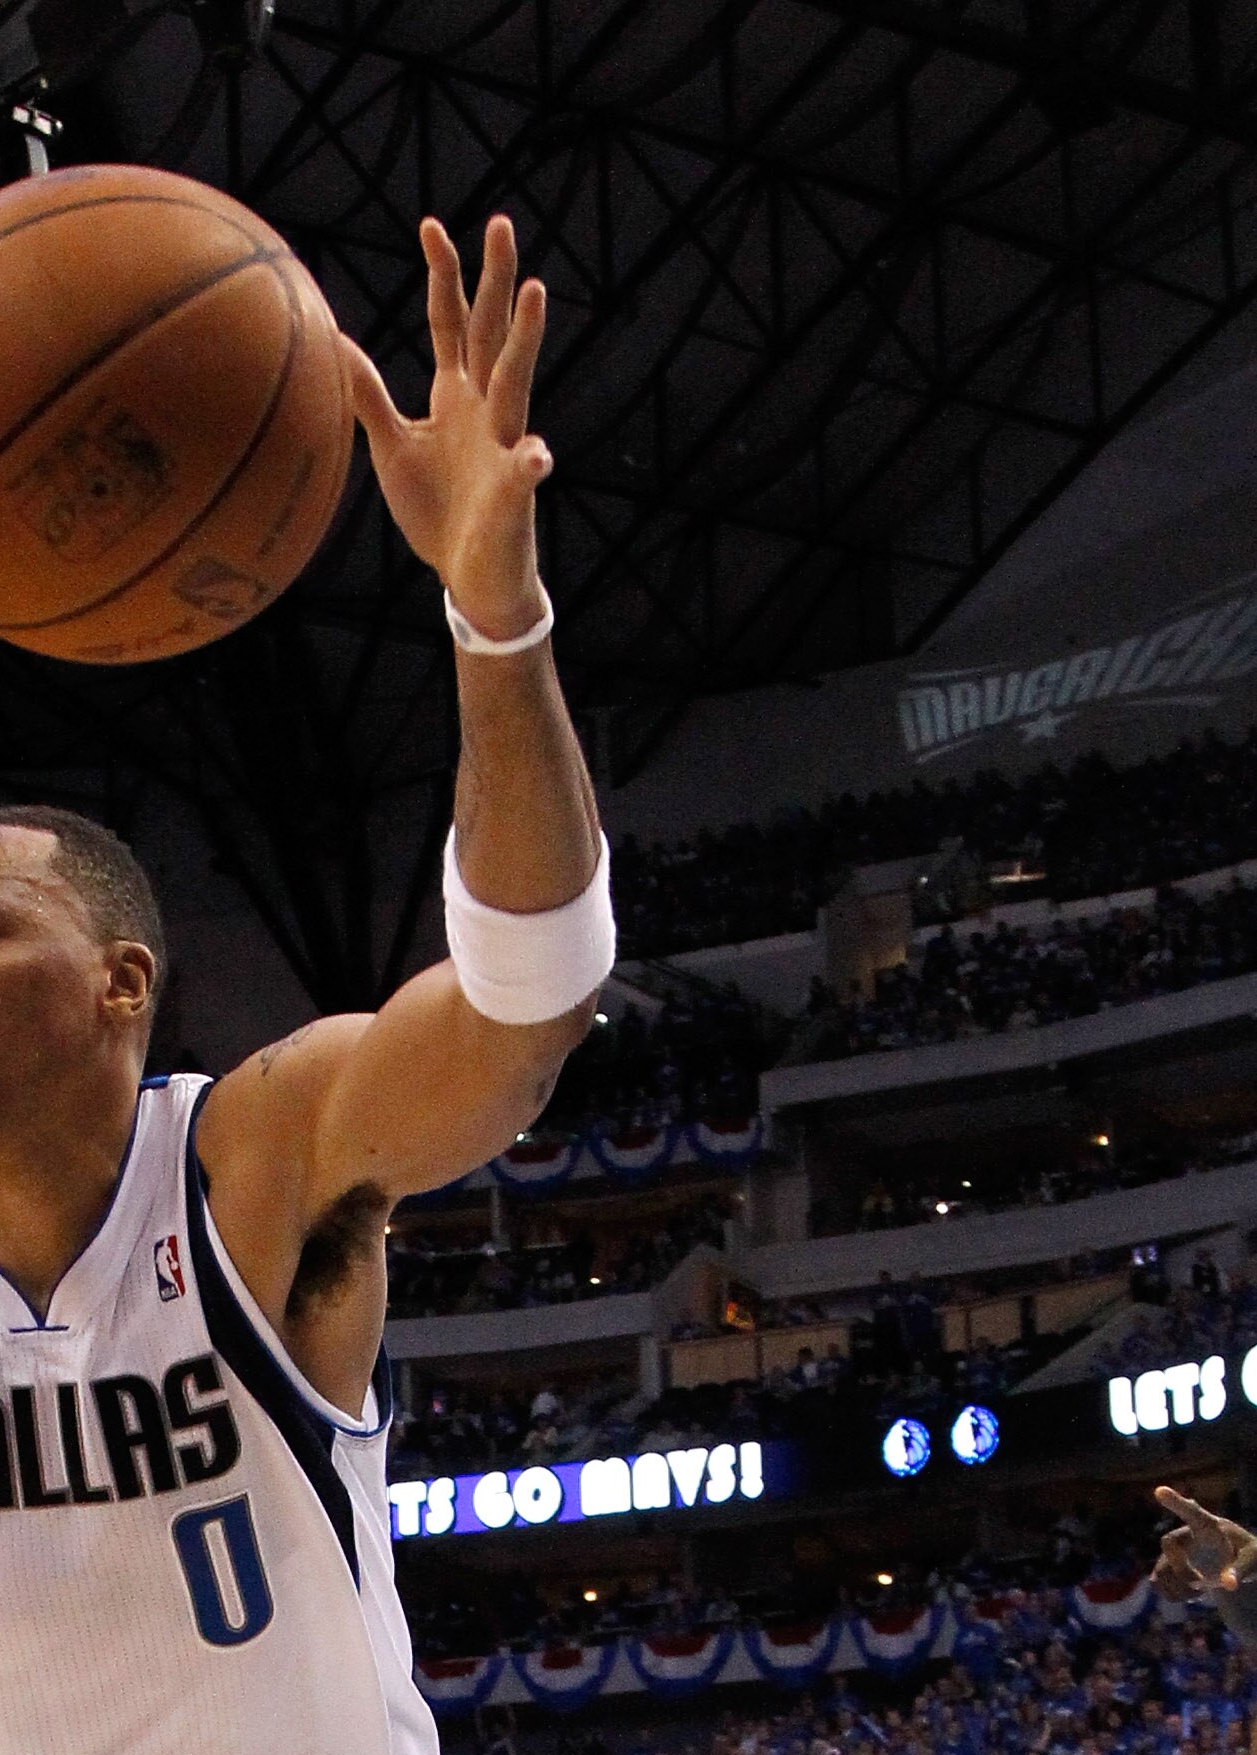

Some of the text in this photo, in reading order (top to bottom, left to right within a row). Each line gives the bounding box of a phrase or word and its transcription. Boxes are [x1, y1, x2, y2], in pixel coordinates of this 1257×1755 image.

[1109, 1355, 1226, 1435] LETS
[473, 1466, 562, 1528] GO
[580, 1442, 764, 1516] MAVS!
[171, 1491, 275, 1652] 0
